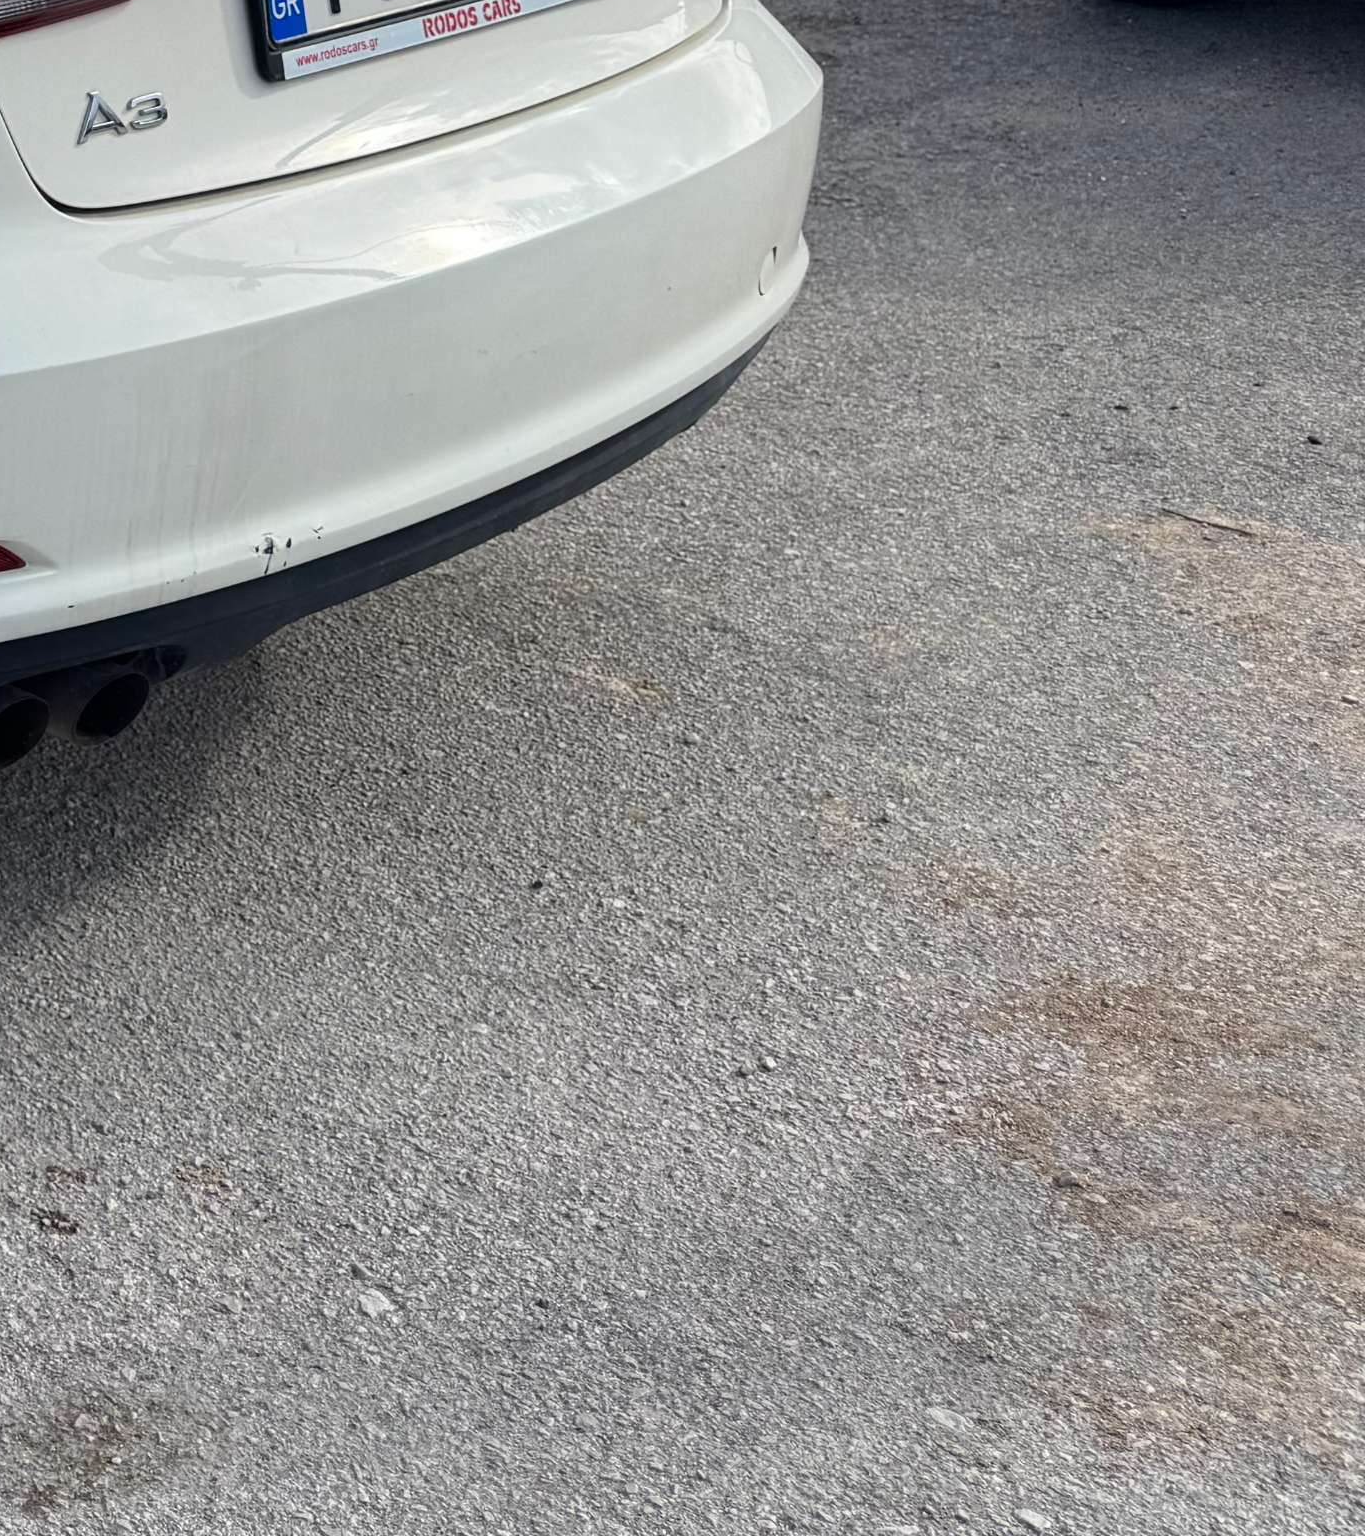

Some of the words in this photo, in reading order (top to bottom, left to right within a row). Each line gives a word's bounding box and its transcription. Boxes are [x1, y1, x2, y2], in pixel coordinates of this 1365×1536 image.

[422, 8, 479, 38] RODOS
[295, 36, 379, 68] www.rodoscars.gr
[75, 90, 168, 146] A3
